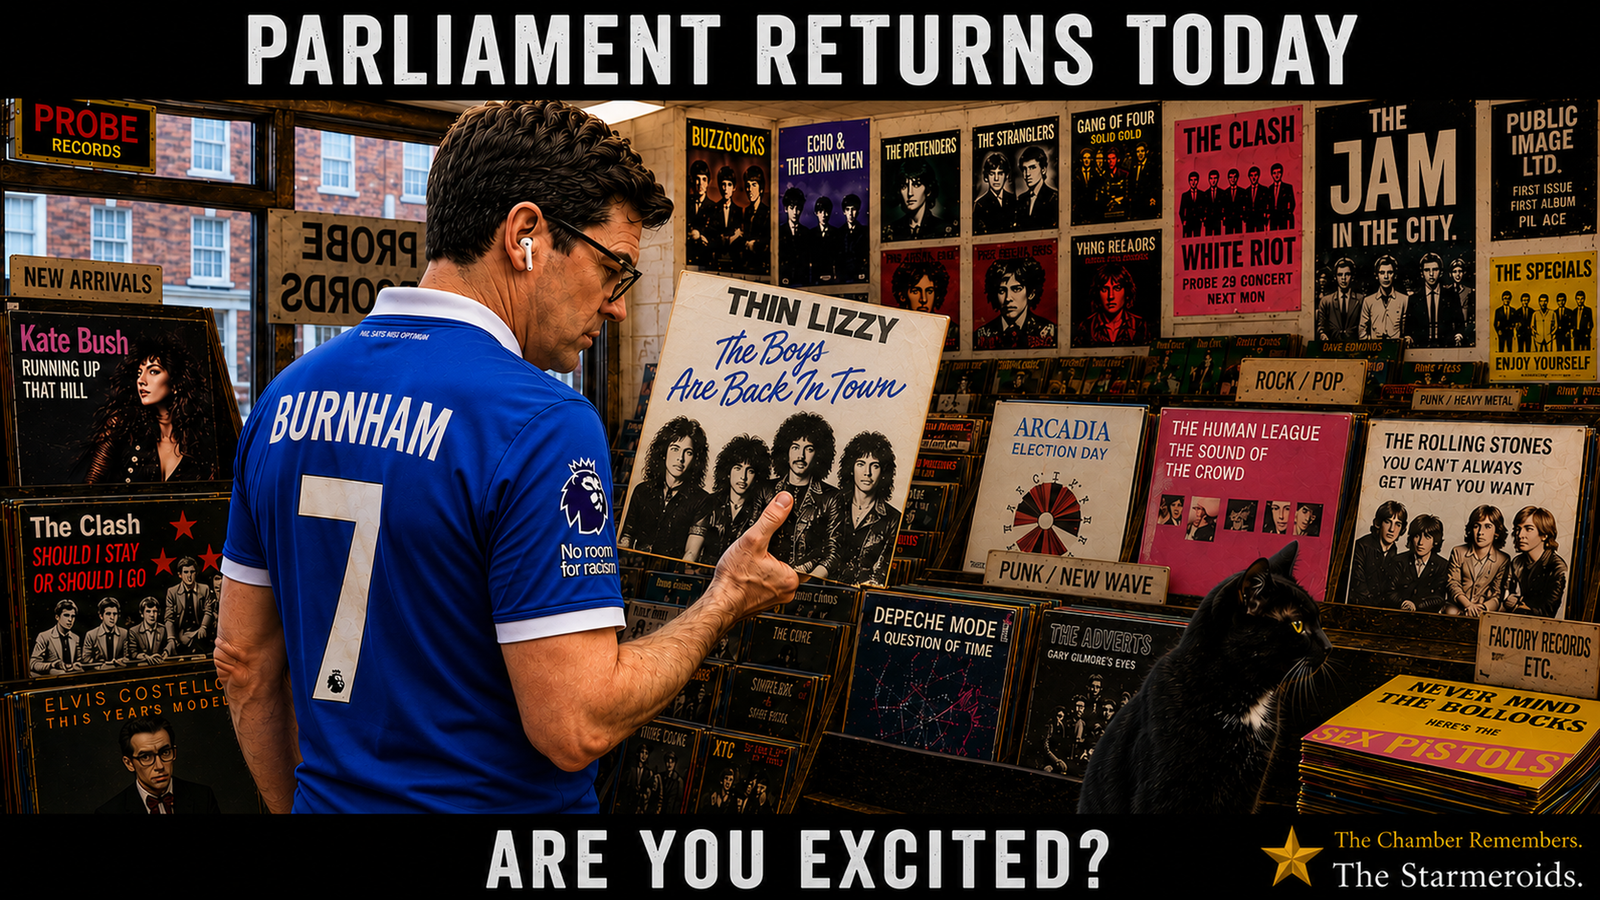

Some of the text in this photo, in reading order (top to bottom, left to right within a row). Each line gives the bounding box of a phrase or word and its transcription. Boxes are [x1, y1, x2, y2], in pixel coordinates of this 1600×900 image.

[34, 103, 139, 144] PROBE
[1077, 110, 1155, 133] GANG OF FOUR
[1369, 105, 1407, 133] THE
[1507, 105, 1578, 134] PUBLIC
[692, 125, 765, 156] BUZZCOCKS
[807, 132, 845, 153] ECHO &
[977, 124, 1055, 149] THE STRANGLERS
[1090, 129, 1142, 145] SOLID GOLD
[1183, 115, 1295, 155] THE CLASH
[1512, 129, 1574, 155] IMAGE
[52, 138, 121, 159] RECORDS
[885, 137, 957, 161] THE PRETENDERS
[786, 151, 863, 176] THE BUNNYMEN
[1330, 128, 1457, 215] JAM
[1523, 154, 1562, 177] LTD.
[1513, 181, 1573, 196] FIRST ISSUE
[1510, 196, 1576, 211] FIRST ALBUM
[1332, 214, 1457, 248] IN THE CITY.
[1519, 212, 1567, 228] PIL ACE
[1181, 237, 1296, 271] WHITE RIOT
[24, 267, 152, 294] NEW ARRIVALS
[1182, 272, 1293, 290] PROBE 29 CONCERT
[1495, 259, 1592, 282] THE SPECIALS
[1207, 291, 1265, 305] NEXT MON
[727, 286, 900, 344] THIN LIZZY
[20, 323, 129, 355] Kate Bush
[715, 329, 830, 376] The Boys
[1495, 356, 1591, 370] ENJOY YOURSELF
[22, 359, 101, 378] RUNNING UP
[1255, 371, 1297, 390] ROCK
[22, 381, 88, 399] THAT HILL
[666, 367, 907, 407] Are Back In Town
[1419, 394, 1444, 406] PUNK
[1453, 395, 1483, 406] HEAVY
[1484, 395, 1513, 406] METAL
[269, 390, 453, 462] BURNHAM
[1013, 417, 1111, 442] ARCADIA
[1172, 420, 1321, 442] THE HUMAN LEAGUE
[1011, 442, 1109, 461] ELECTION DAY
[1169, 442, 1268, 462] THE SOUND OF
[1384, 433, 1553, 455] THE ROLLING STONES
[1166, 462, 1245, 482] THE CROWD
[1382, 456, 1523, 475] YOU CAN'T ALWAYS
[1378, 475, 1535, 496] GET WHAT YOU WANT
[29, 513, 141, 538] The Clash
[32, 542, 140, 567] SHOULD I STAY
[560, 543, 613, 559] No room
[34, 568, 146, 594] OR SHOULD I GO
[560, 560, 617, 577] for racism
[999, 560, 1045, 583] PUNK
[1060, 566, 1100, 590] NEW
[1104, 572, 1154, 596] WAVE
[298, 474, 383, 703] 7
[873, 606, 946, 632] DEPECHE
[950, 615, 998, 639] MODE
[872, 629, 994, 658] A QUESTION OF TIME
[1050, 623, 1153, 656] THE ADVERTS
[1488, 625, 1592, 658] FACTORY RECORDS
[1047, 649, 1136, 670] GARY GILMORE'S EYES
[45, 677, 225, 713] ELVIS COSTELLO
[1407, 681, 1581, 715] NEVER MIND
[46, 695, 229, 729] THIS YEAR'S MODEL
[1377, 691, 1588, 733] THE BOLLOCKS
[1312, 727, 1384, 748] SEX
[1425, 718, 1502, 737] HERE'S THE
[713, 739, 736, 760] XTC
